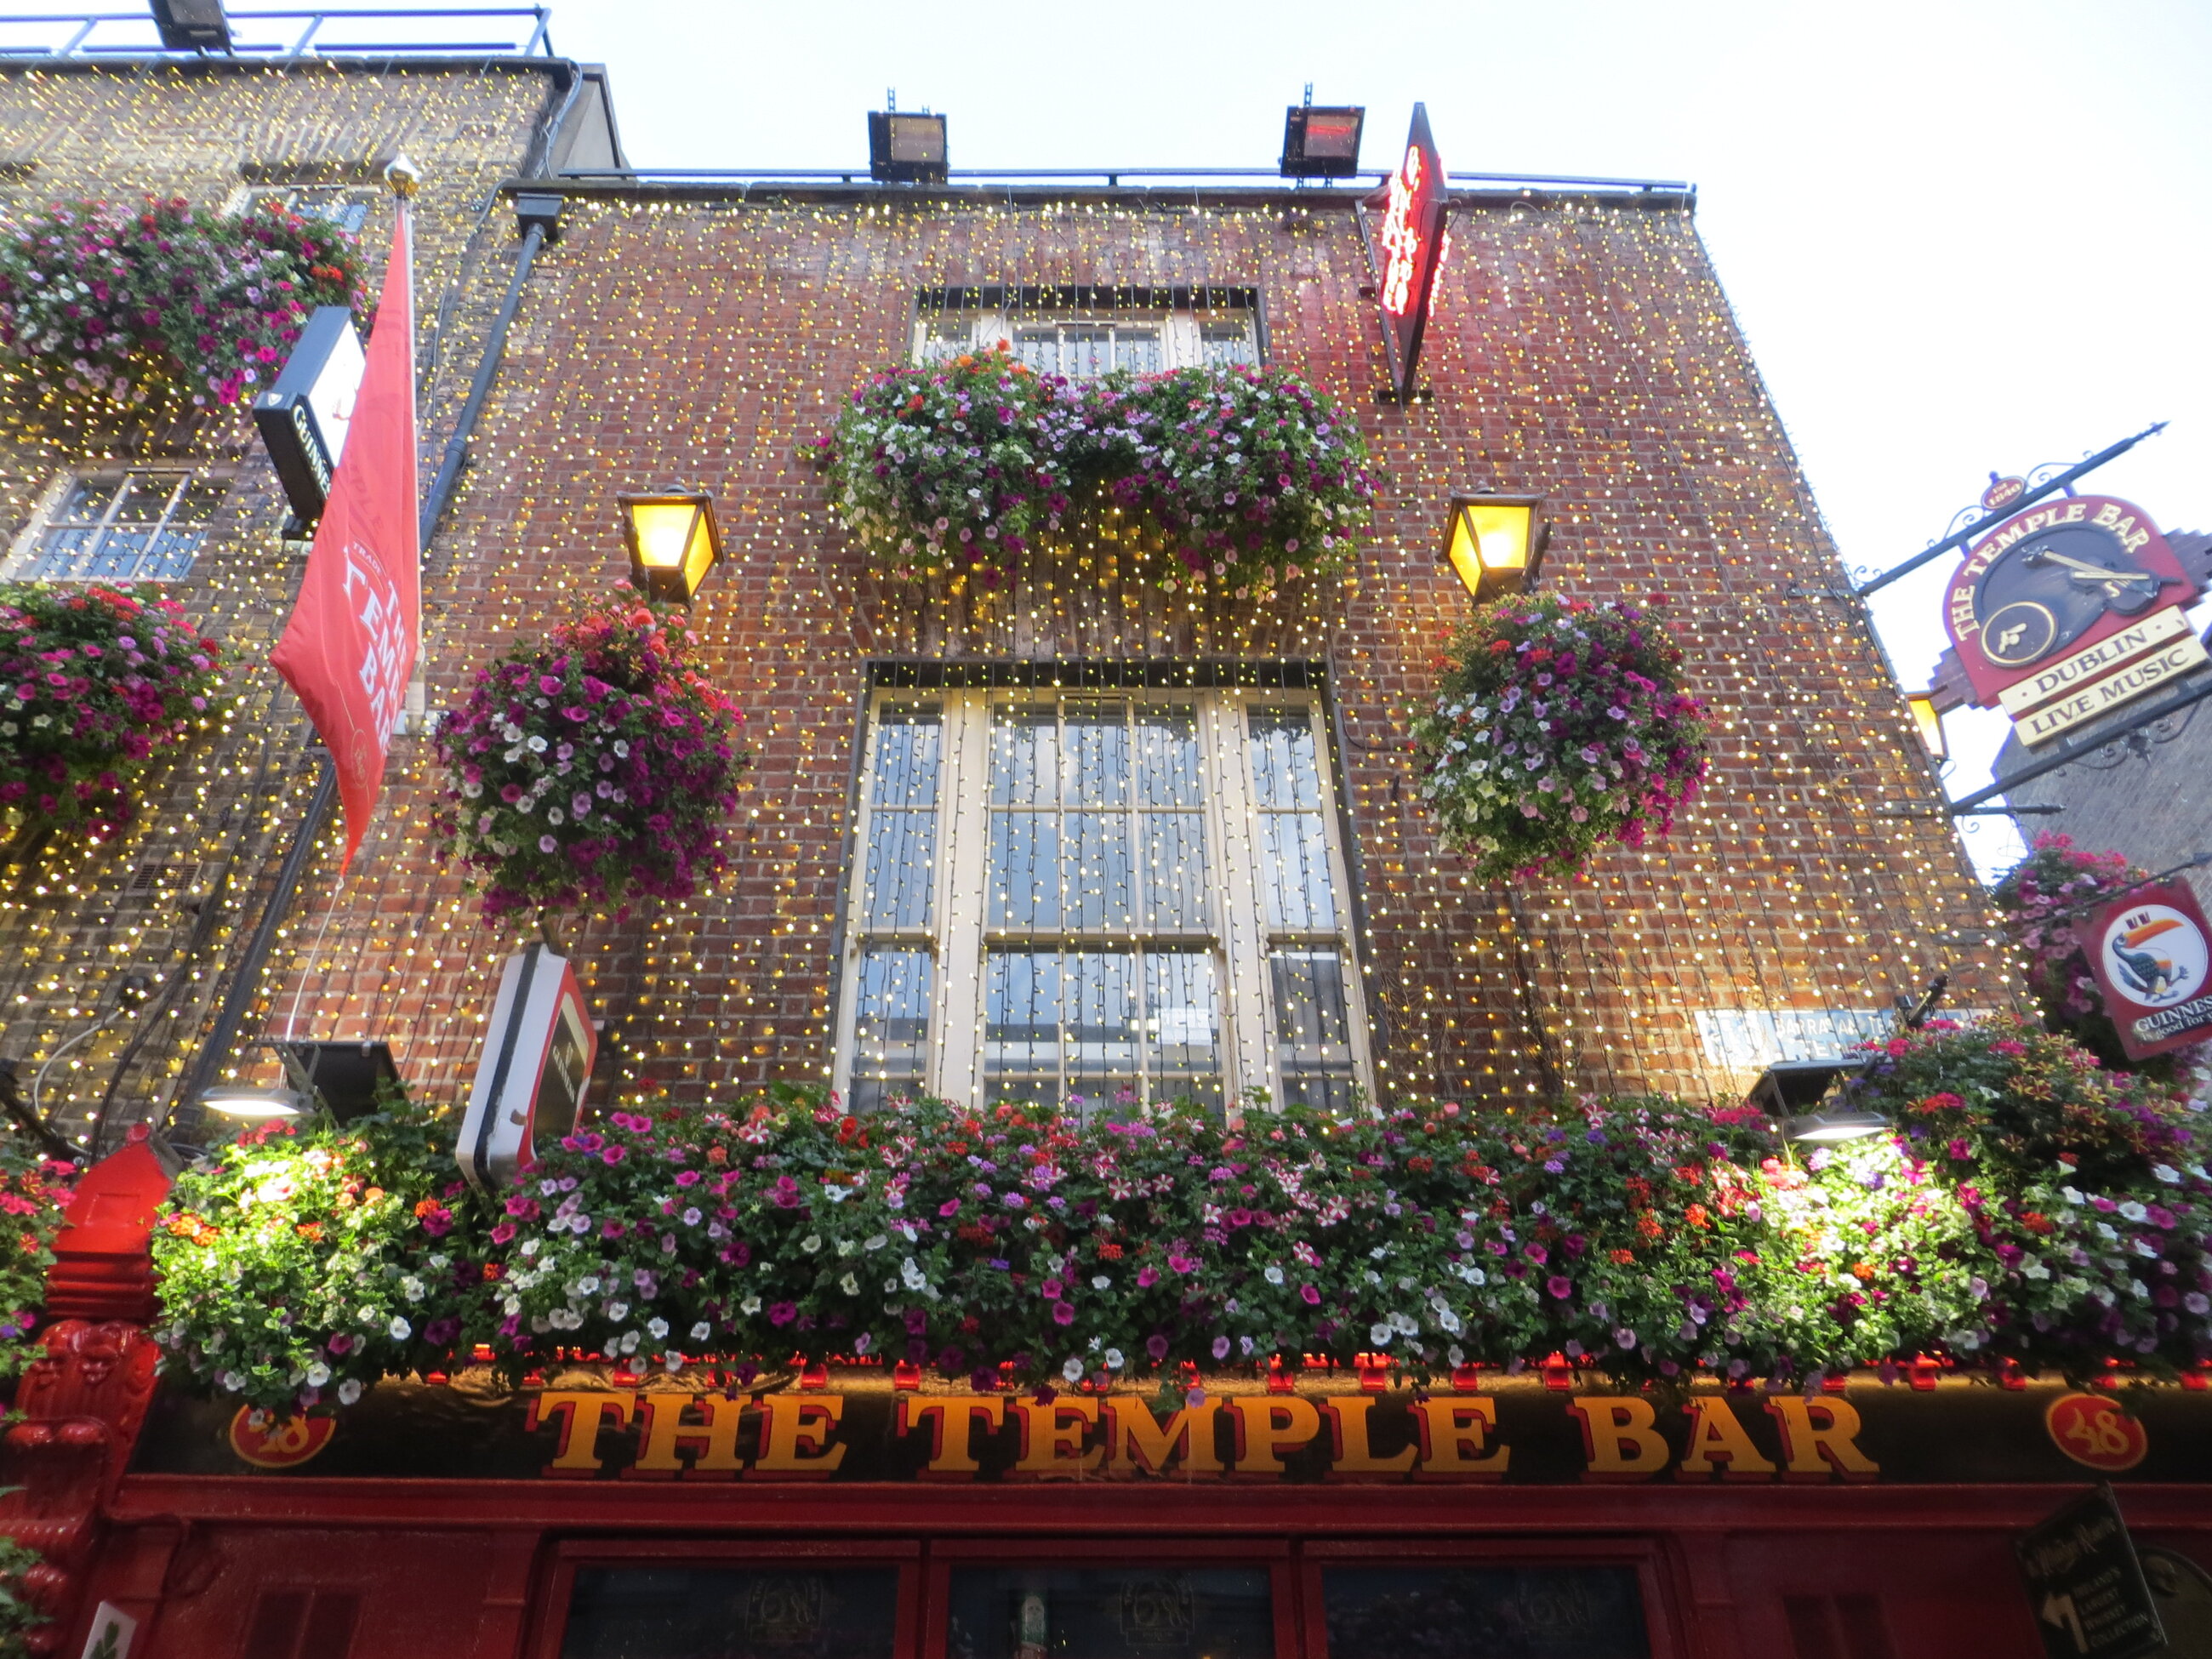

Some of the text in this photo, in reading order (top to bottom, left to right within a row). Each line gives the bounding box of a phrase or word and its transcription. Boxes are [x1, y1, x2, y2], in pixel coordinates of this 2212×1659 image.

[293, 404, 331, 500] GUINNES
[352, 540, 383, 575] TRADE
[1952, 503, 2150, 641] THE TEMPLE BAR
[2031, 648, 2189, 735] LIVE MUSIC
[2033, 628, 2148, 694] DUBLIN
[2135, 995, 2212, 1032] GUINNES
[2156, 1020, 2185, 1040] good
[2186, 1014, 2204, 1026] for
[534, 1391, 1880, 1474] THE TEMPLE BAR
[2066, 1407, 2129, 1456] 48
